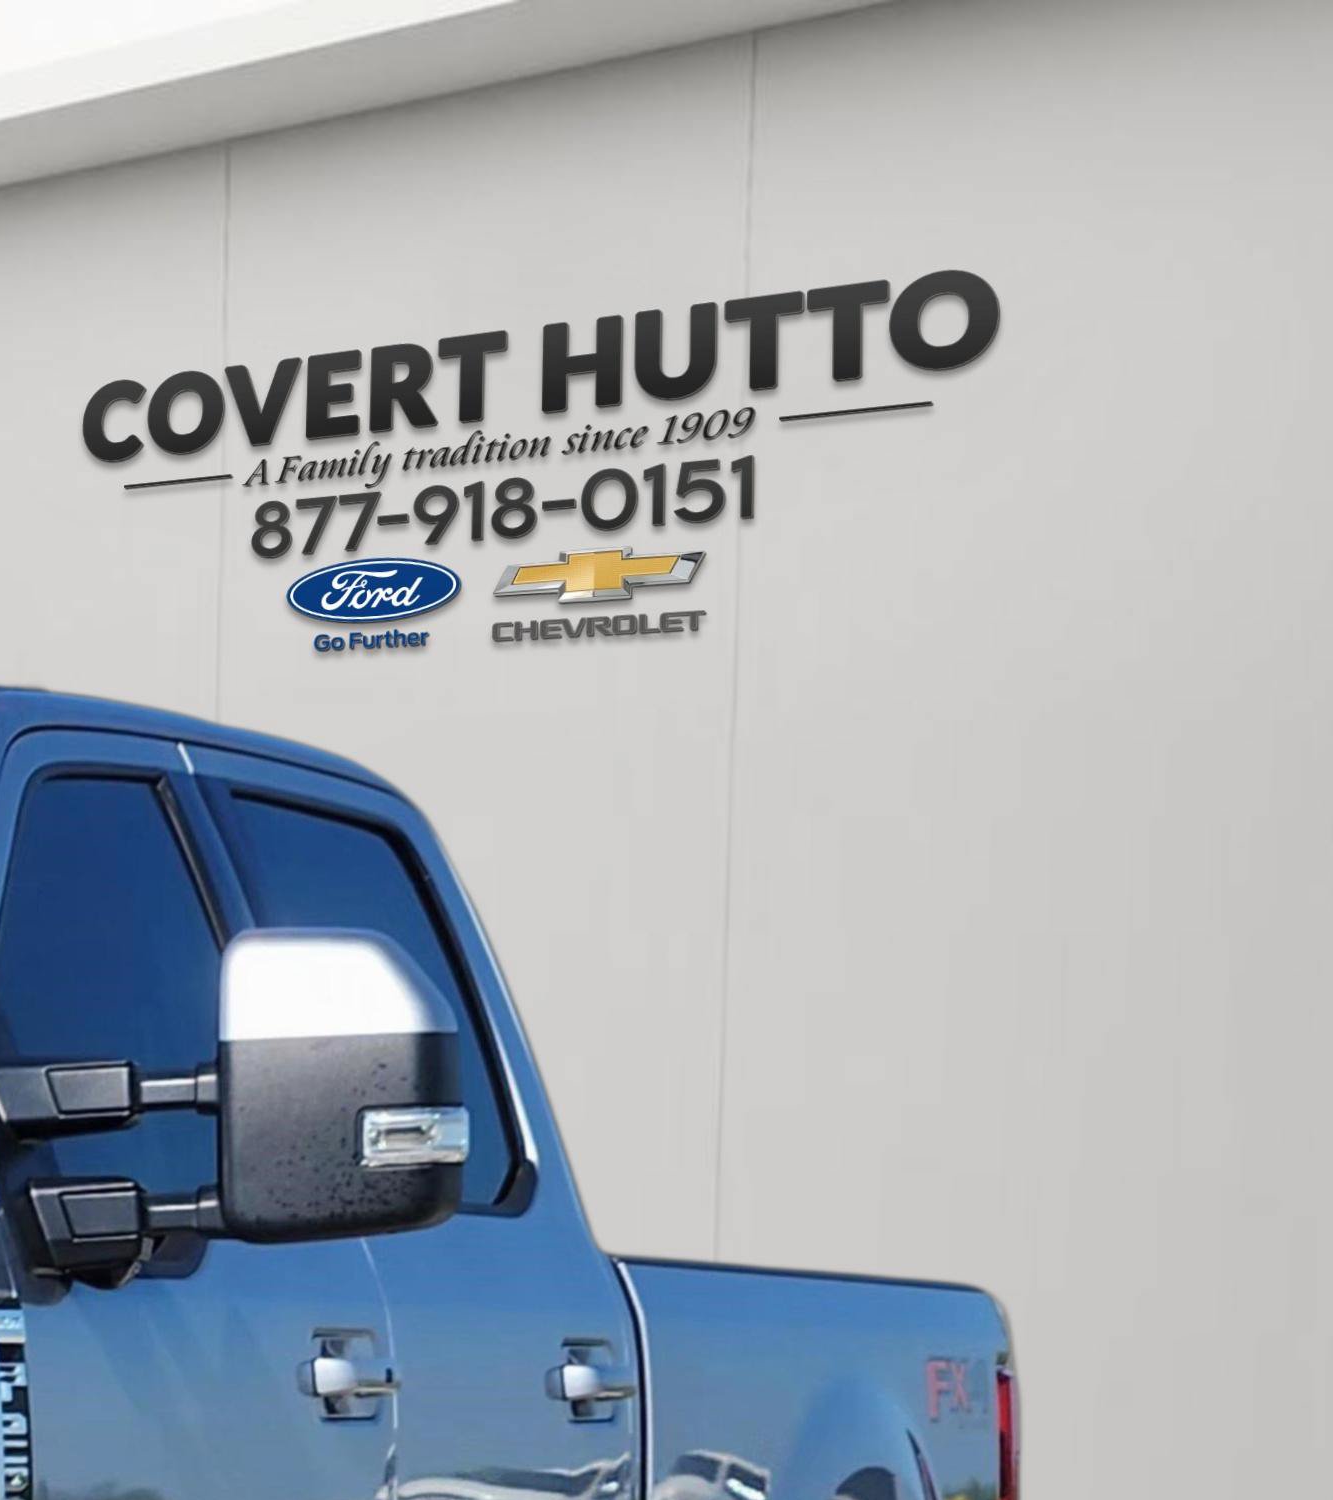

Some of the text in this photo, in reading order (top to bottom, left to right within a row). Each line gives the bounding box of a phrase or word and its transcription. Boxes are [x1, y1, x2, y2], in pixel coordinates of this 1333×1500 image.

[82, 269, 1001, 464] COVERT HUTTO
[242, 406, 756, 489] A Family tradition since 1909
[251, 454, 755, 560] 877-918-0151
[321, 563, 424, 612] Ford
[313, 628, 430, 653] Go Further
[491, 610, 707, 643] CHEVROLET
